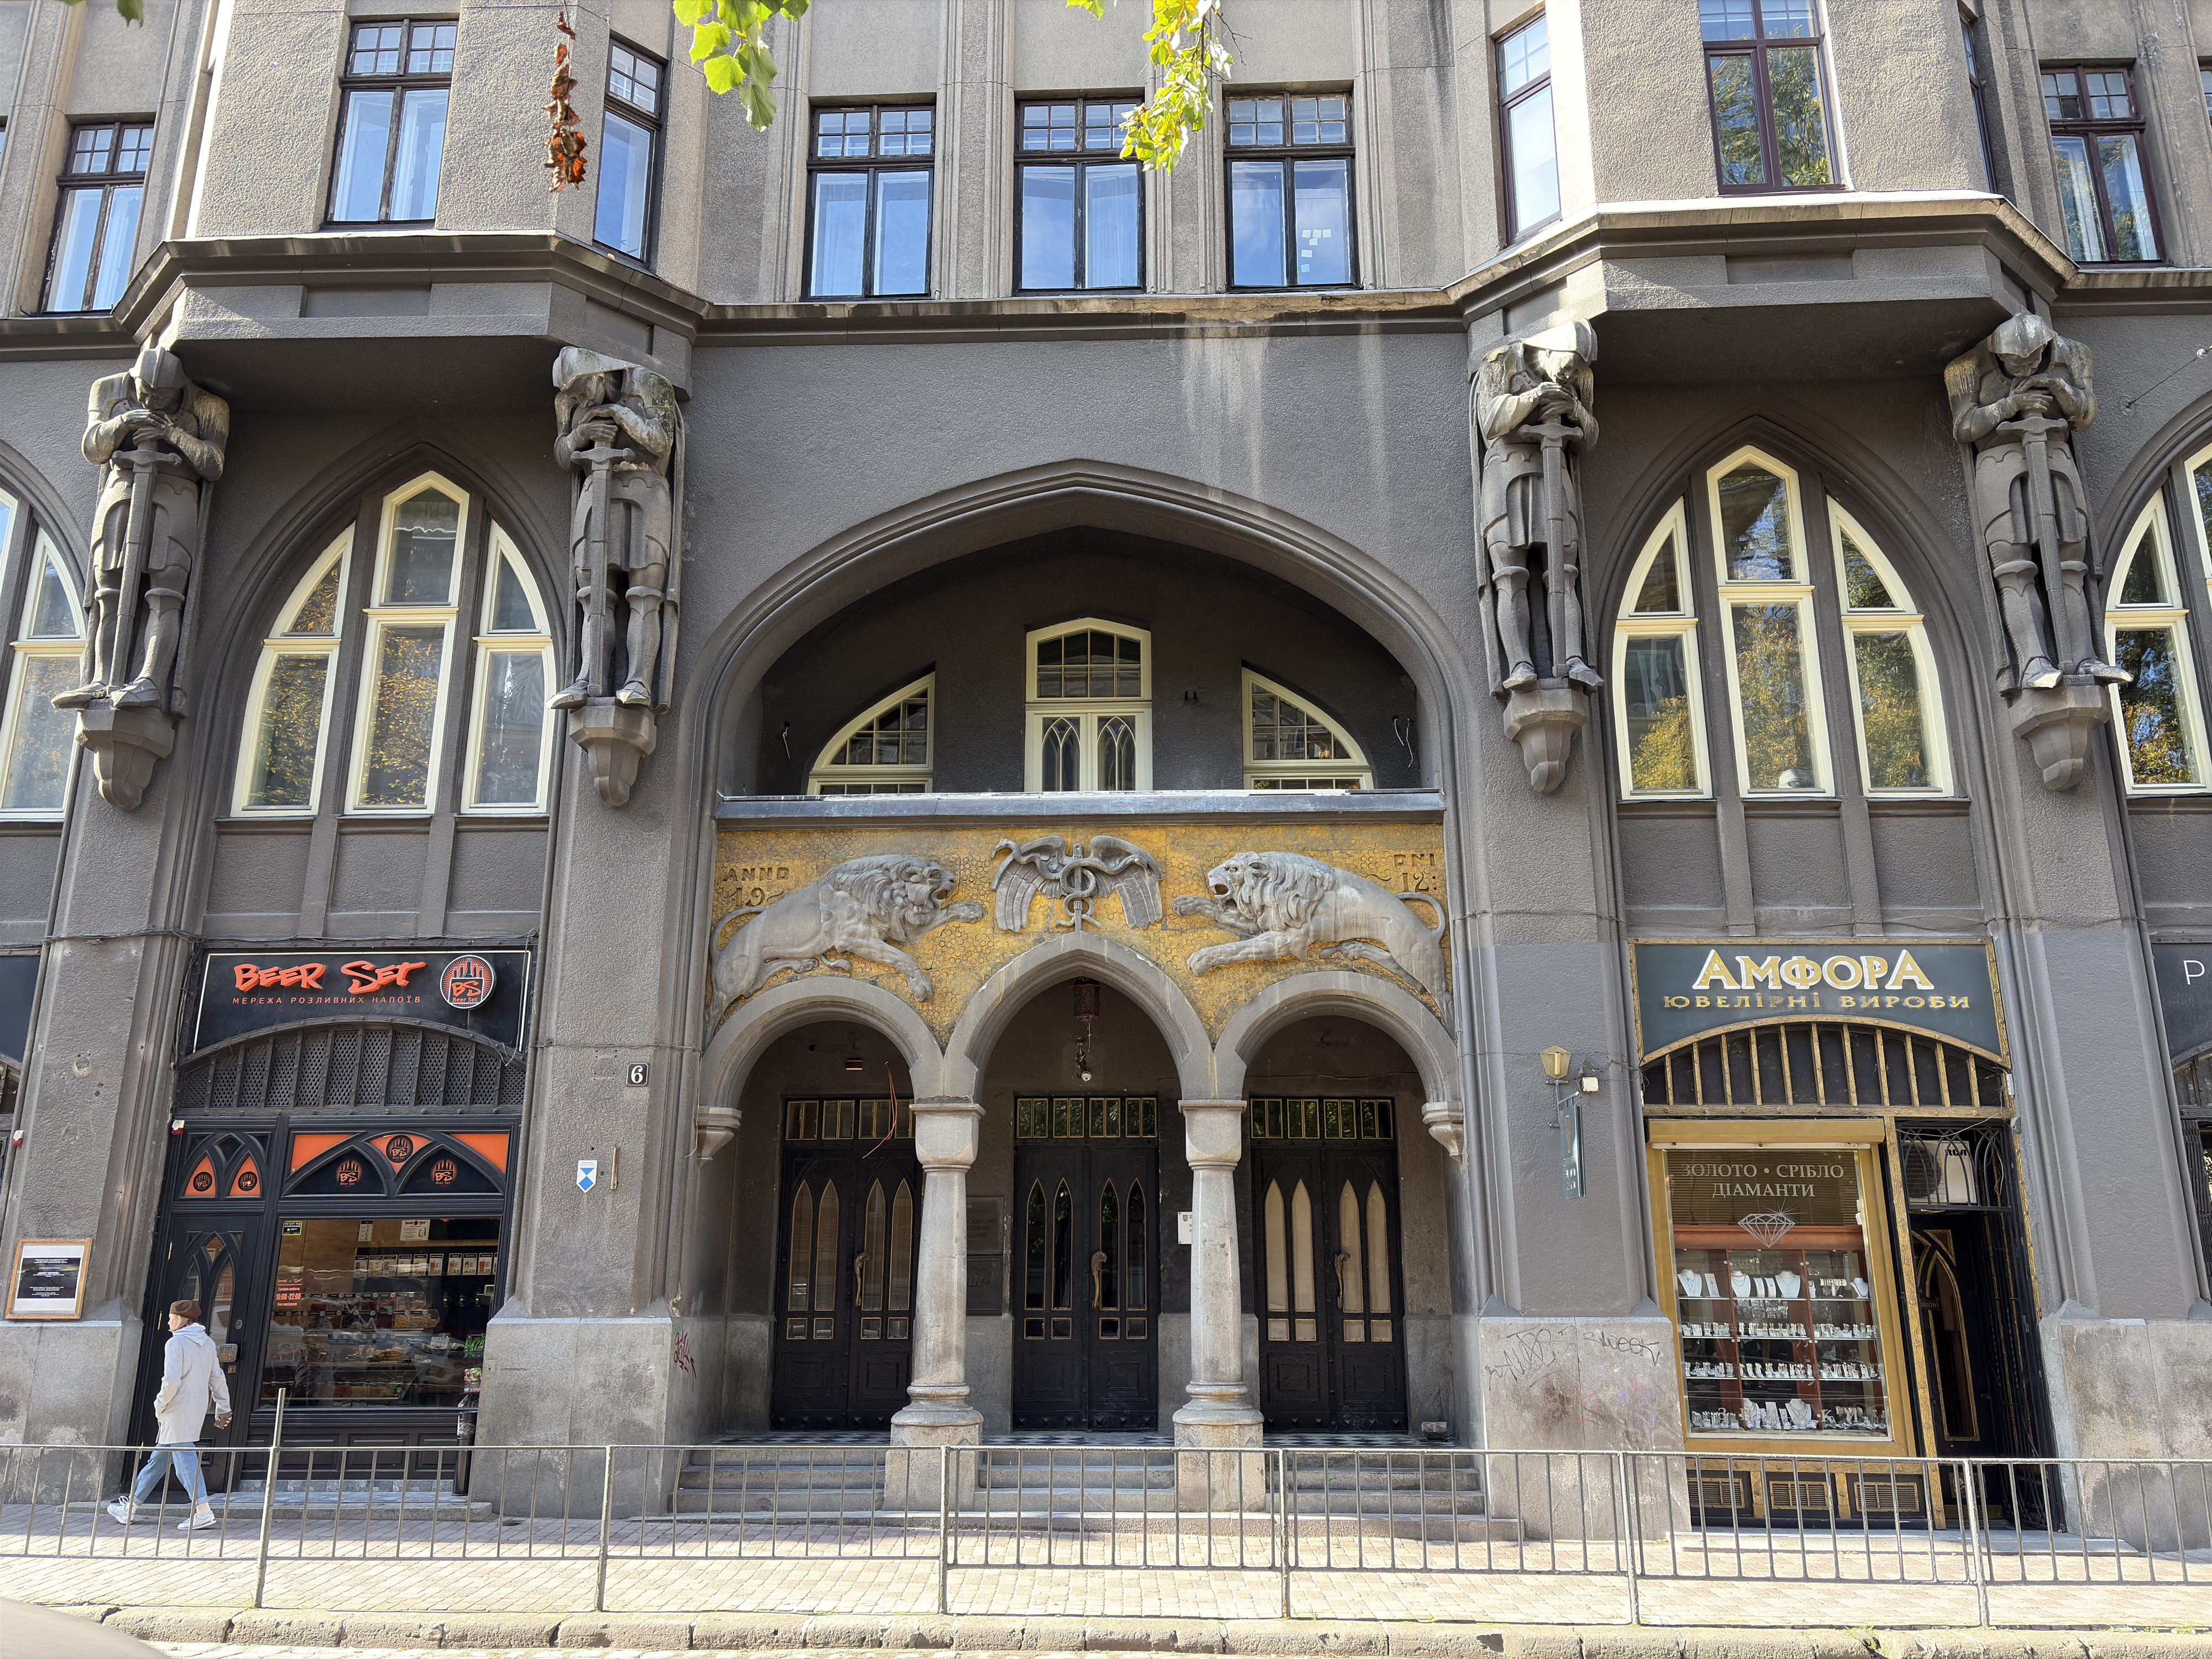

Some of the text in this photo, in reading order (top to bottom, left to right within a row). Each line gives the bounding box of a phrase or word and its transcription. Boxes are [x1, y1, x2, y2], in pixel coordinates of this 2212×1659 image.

[1393, 853, 1436, 867] DNI
[722, 867, 790, 881] ANNO
[729, 887, 766, 907] 19
[1692, 948, 1935, 990] АМФОРА
[451, 980, 482, 997] BS
[372, 995, 421, 1004] НАПОЇВ
[1840, 995, 1970, 1009] ВИРОБИ
[630, 1065, 644, 1083] 6
[392, 1147, 407, 1157] BS
[340, 1172, 357, 1182] BS
[435, 1171, 452, 1182] BS
[1681, 1164, 1844, 1178] ЗОЛОТО СРІБЛО
[1712, 1183, 1815, 1198] ДІАМАНТИ
